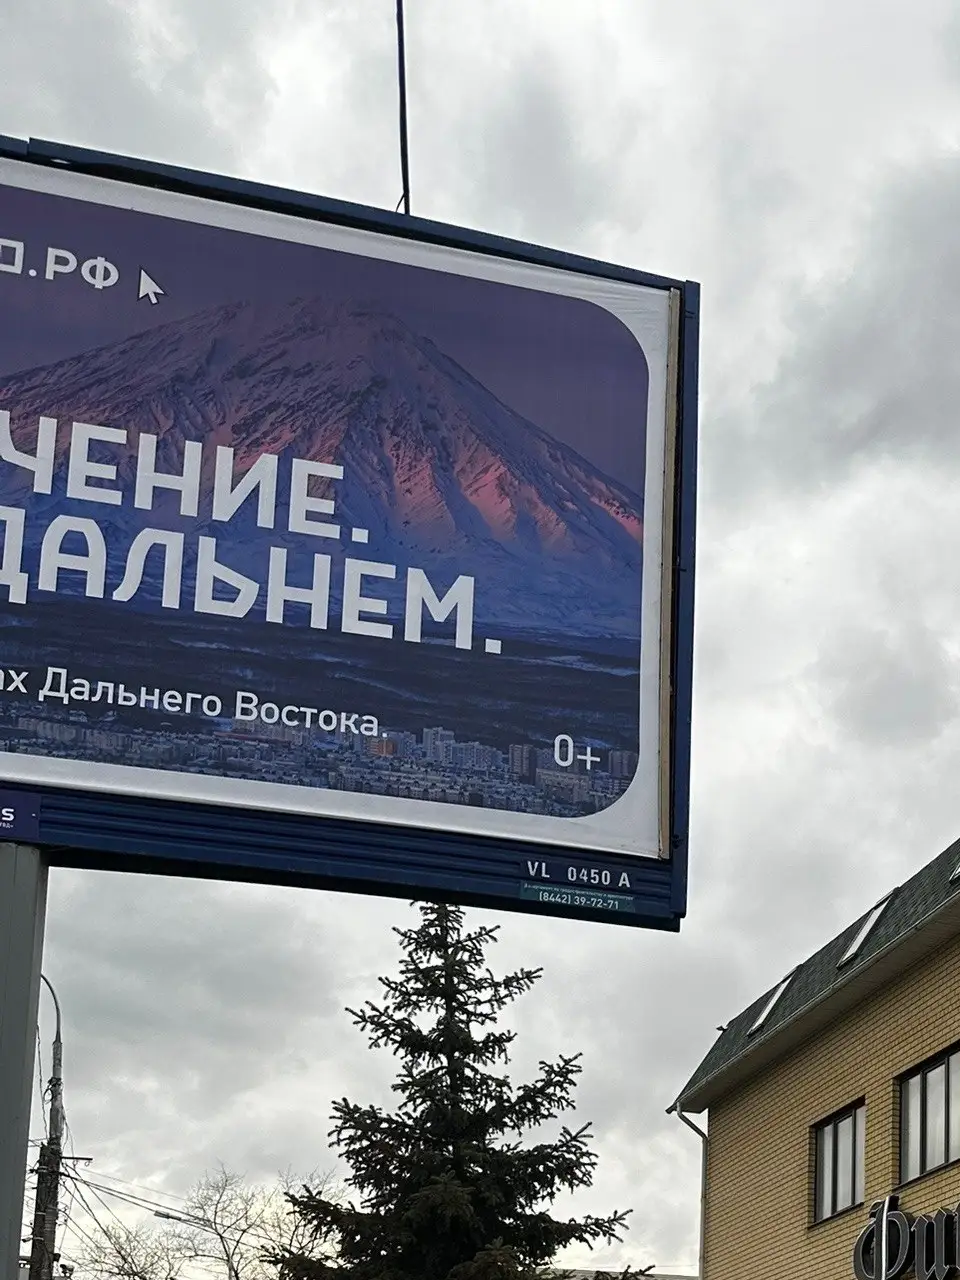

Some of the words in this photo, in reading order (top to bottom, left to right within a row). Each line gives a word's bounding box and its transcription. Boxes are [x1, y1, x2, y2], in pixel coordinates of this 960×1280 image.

[38, 667, 222, 717] Дальнего
[235, 691, 388, 738] Востока.
[554, 734, 601, 770] 0+
[527, 861, 550, 878] VL
[567, 867, 611, 885] 0450
[539, 891, 571, 905] (8442)
[574, 896, 619, 909] 39-72-71
